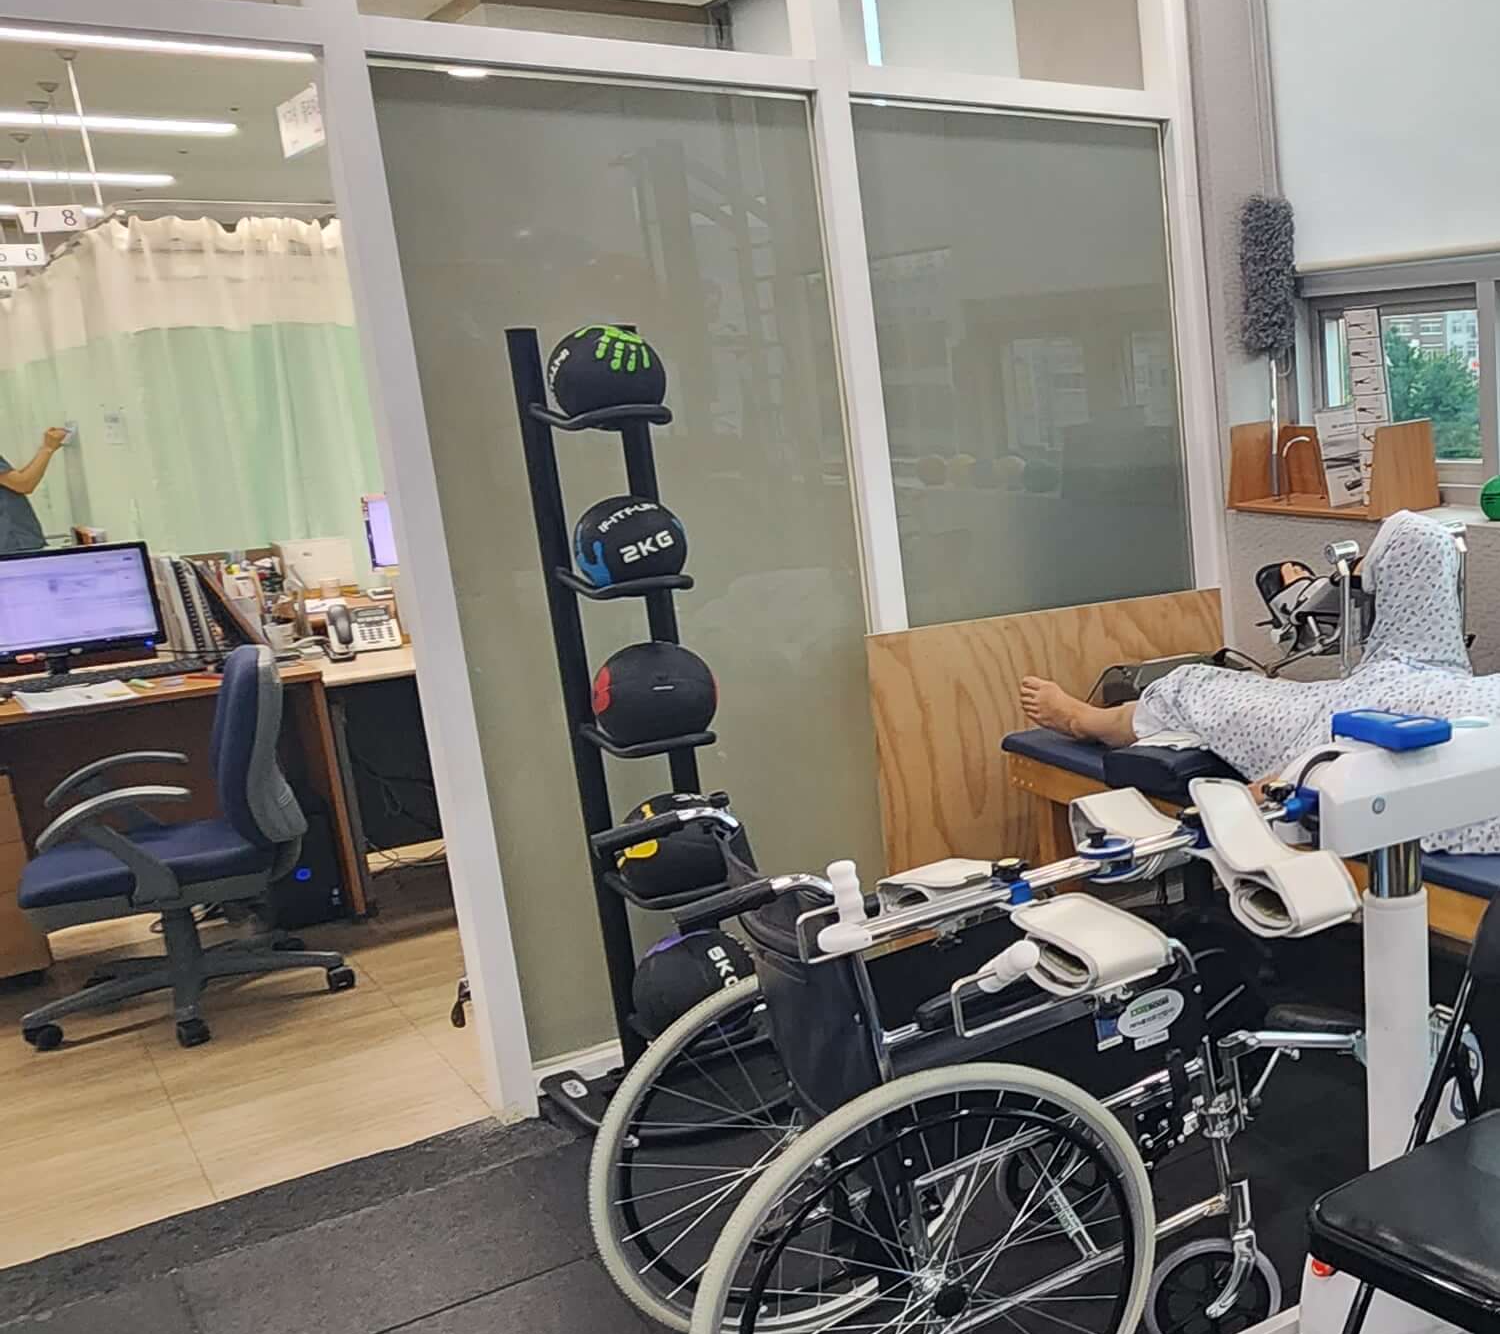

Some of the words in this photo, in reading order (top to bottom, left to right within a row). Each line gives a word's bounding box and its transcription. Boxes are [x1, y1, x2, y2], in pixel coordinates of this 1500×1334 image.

[26, 211, 39, 227] 7
[62, 209, 77, 226] 8
[25, 247, 38, 261] 6
[620, 530, 675, 563] 2KG
